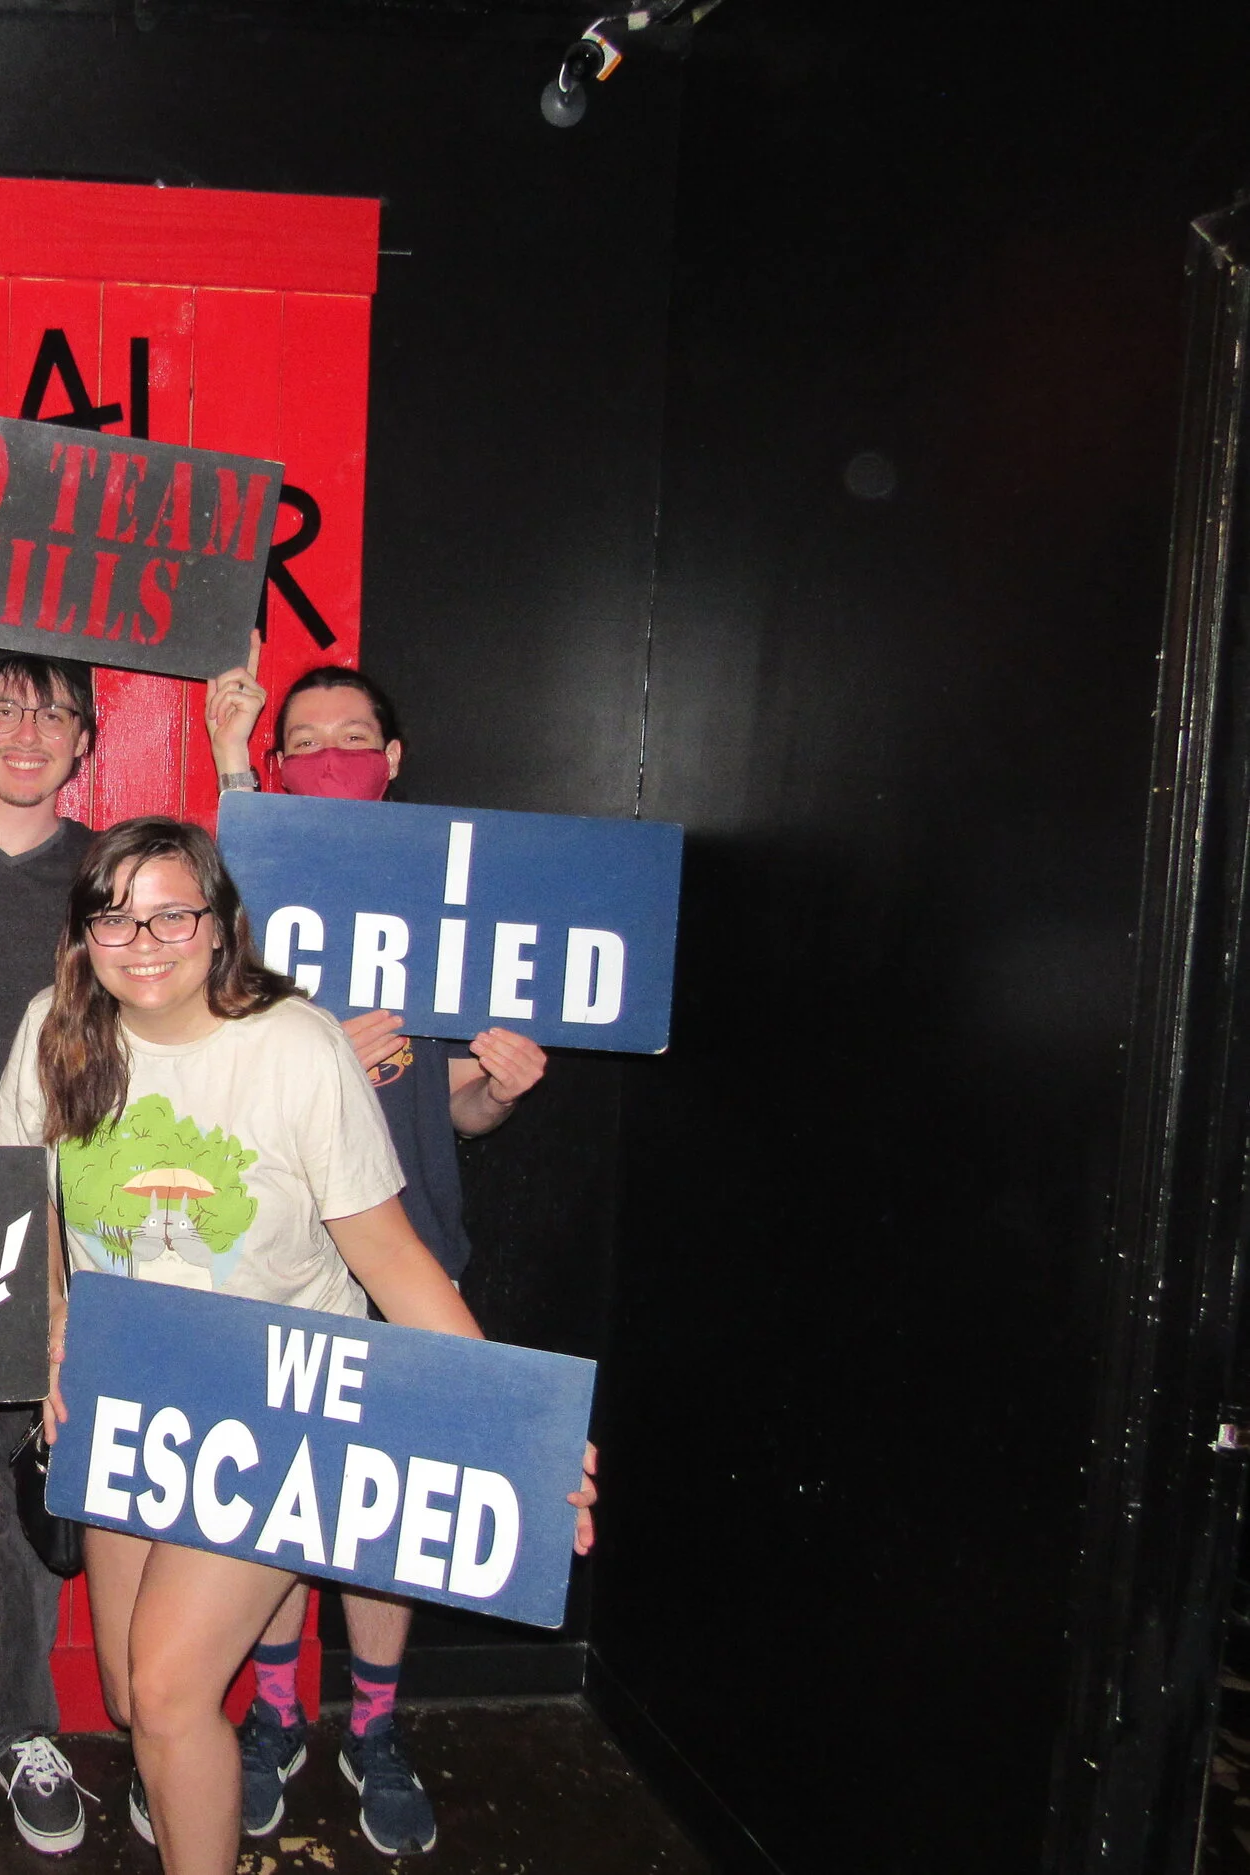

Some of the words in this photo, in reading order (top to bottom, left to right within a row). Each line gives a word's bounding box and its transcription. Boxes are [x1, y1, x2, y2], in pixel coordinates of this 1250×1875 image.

[49, 442, 271, 562] TEAM
[444, 822, 472, 905] I
[264, 906, 624, 1024] CRIED
[268, 1325, 369, 1423] WE
[85, 1396, 519, 1598] ESCAPED
